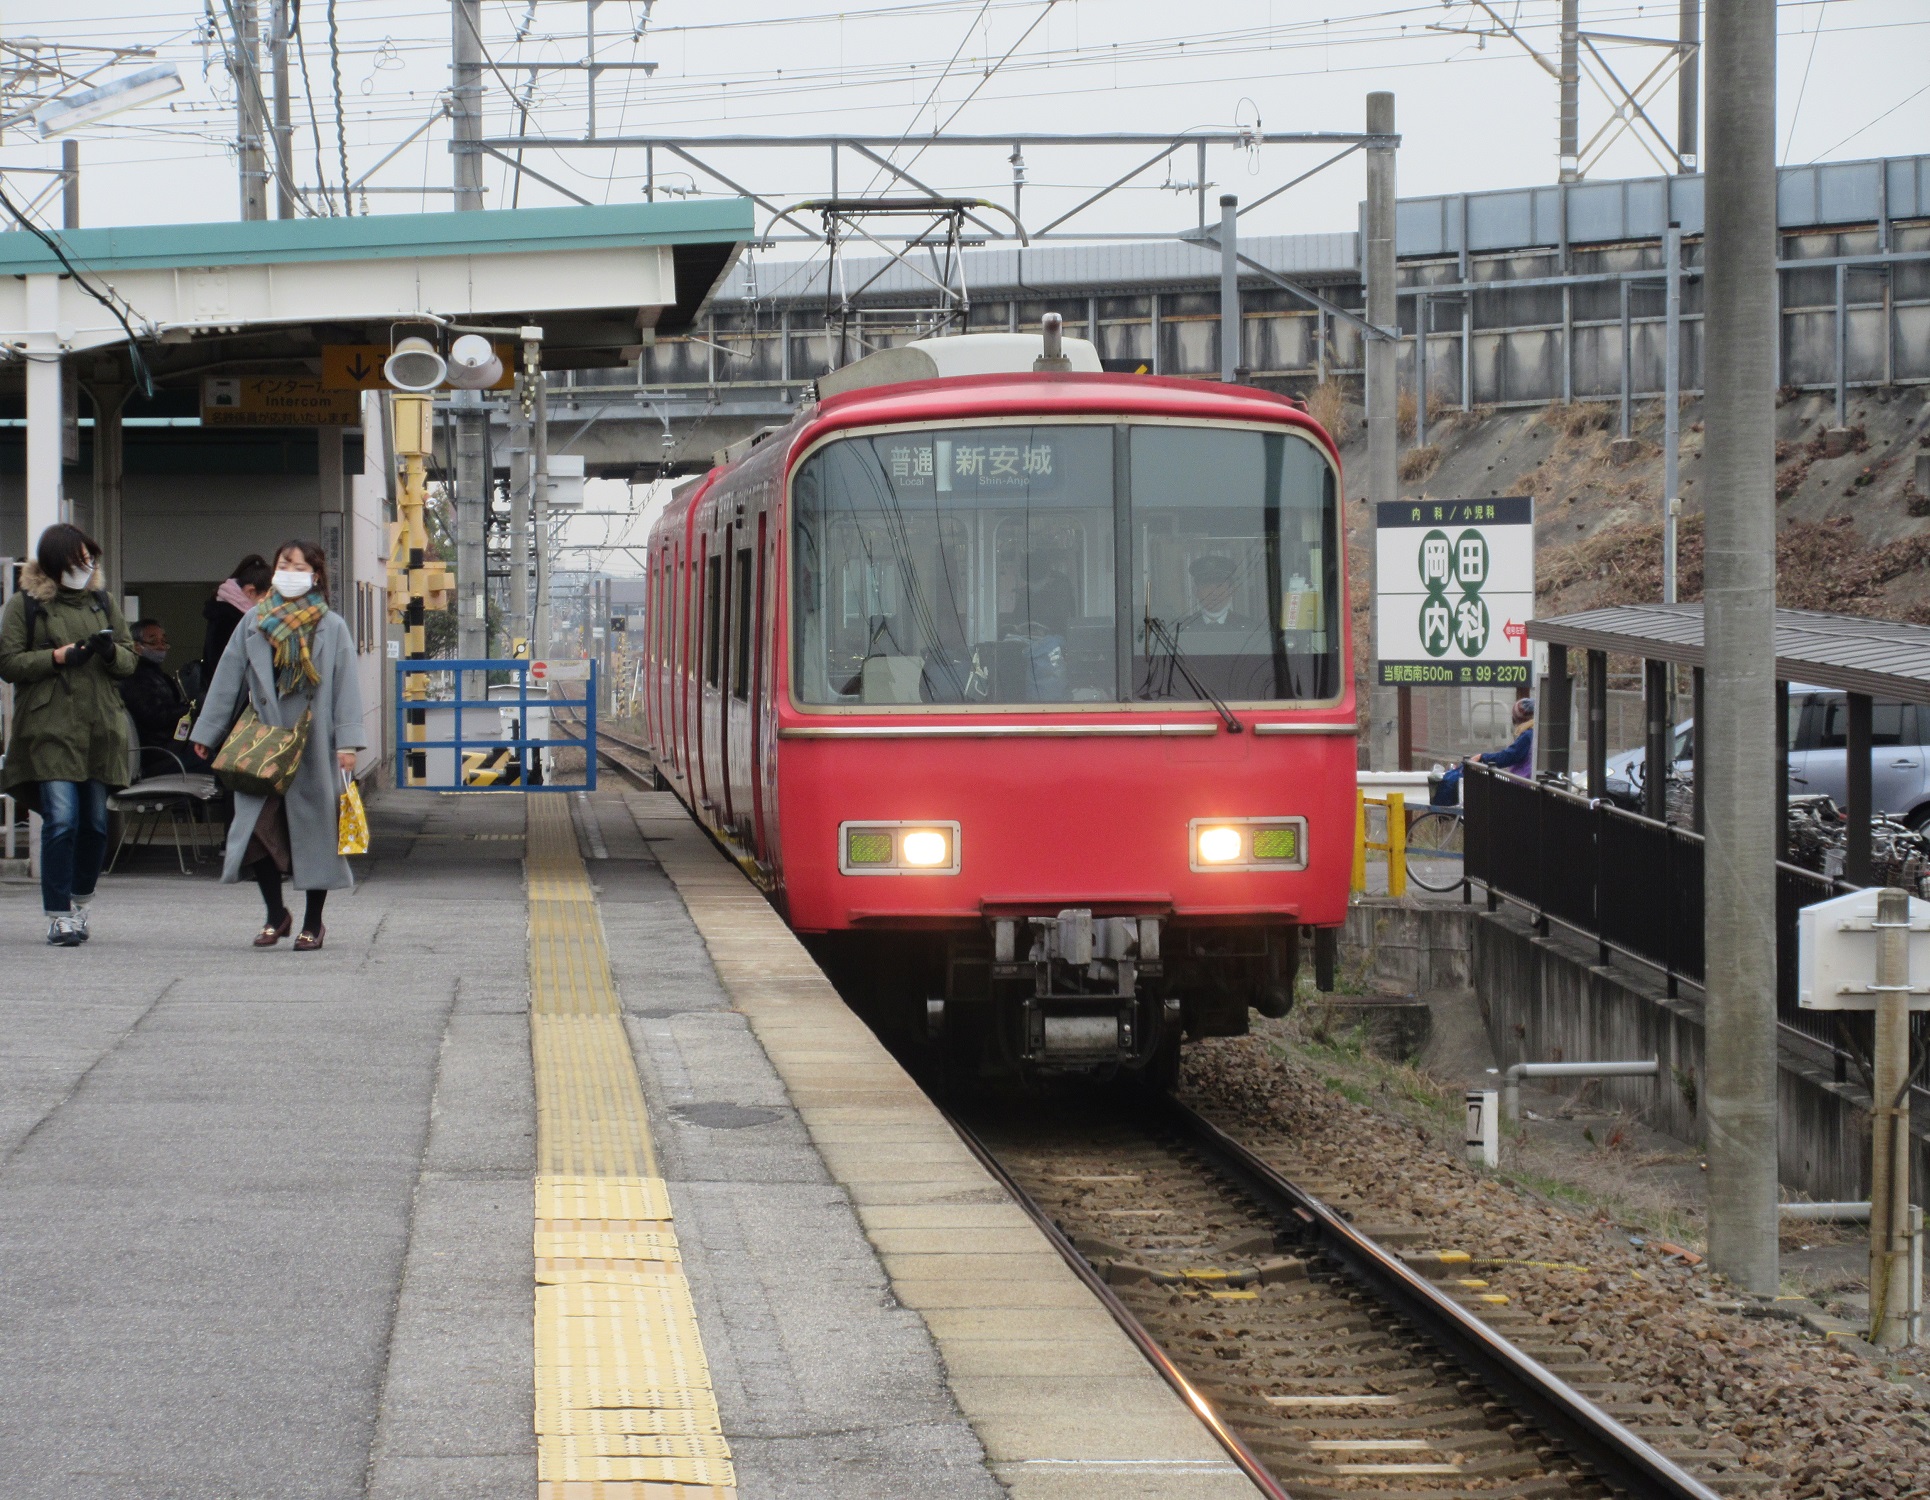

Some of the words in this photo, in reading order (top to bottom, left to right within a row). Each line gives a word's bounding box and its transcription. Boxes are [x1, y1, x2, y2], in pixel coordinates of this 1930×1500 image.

[265, 395, 332, 407] Intercom
[891, 446, 933, 477] 普通
[955, 445, 1053, 476] 新安城
[900, 477, 924, 486] Local
[979, 476, 1030, 486] Shin-Anjo
[1424, 539, 1484, 585] 岡田
[1424, 600, 1486, 649] 内科
[1384, 665, 1453, 682] 当駅西南500m
[1476, 665, 1527, 682] 99-2370
[1468, 1104, 1482, 1135] 7
